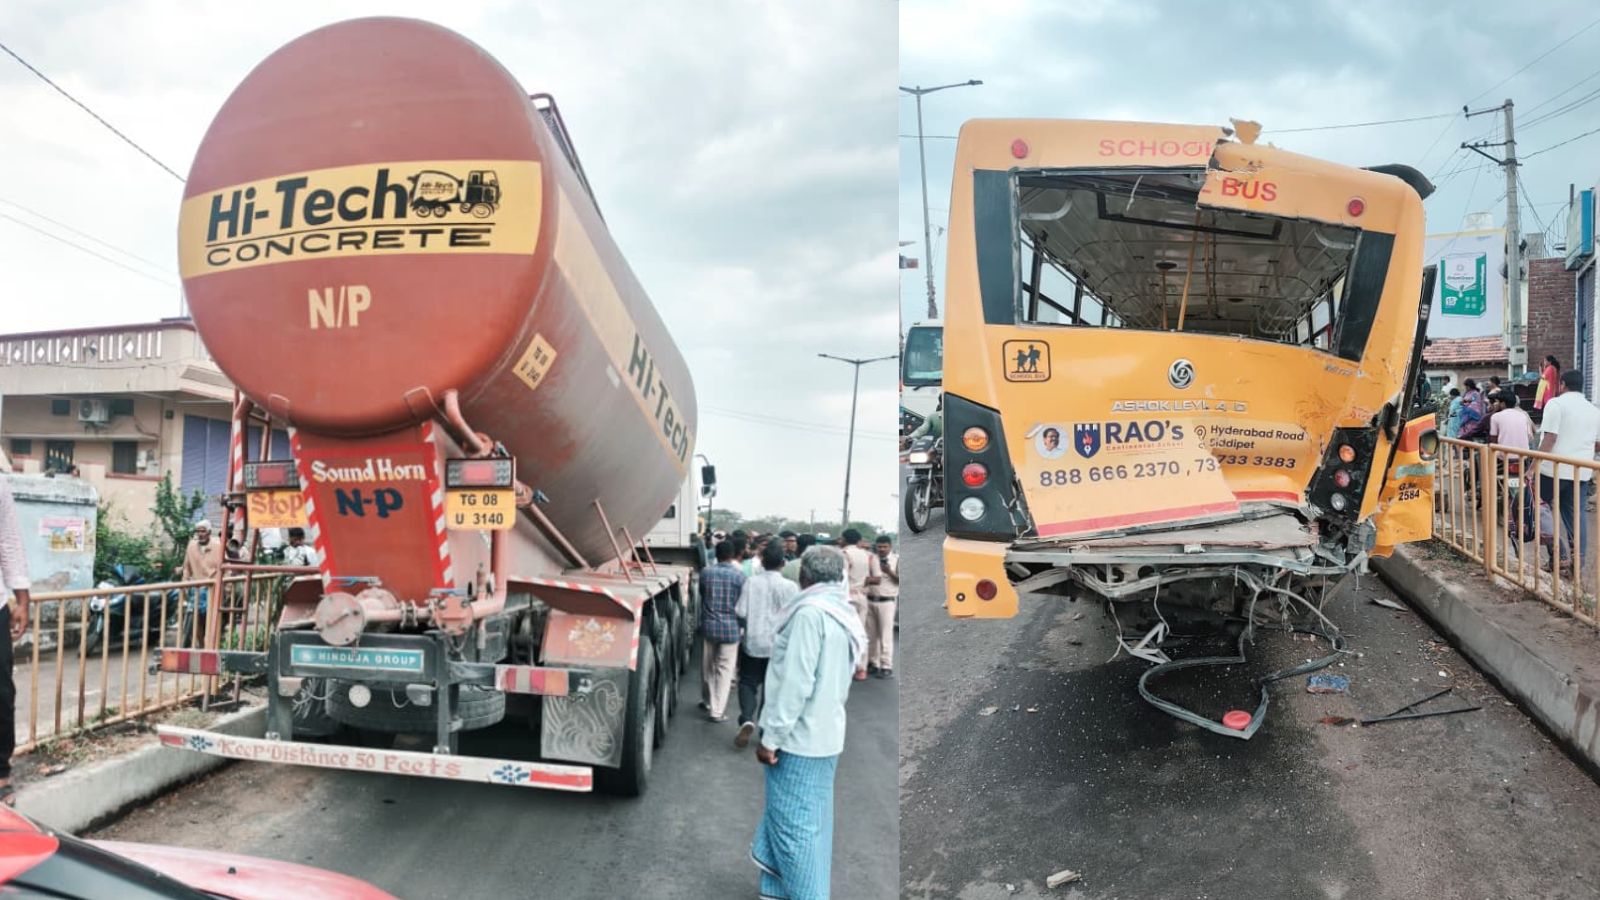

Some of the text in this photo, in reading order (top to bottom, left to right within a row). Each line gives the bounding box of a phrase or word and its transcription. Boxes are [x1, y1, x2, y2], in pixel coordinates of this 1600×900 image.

[1222, 176, 1277, 201] BUS
[207, 168, 409, 242] Hi-Tech
[207, 227, 493, 267] CONCRETE
[308, 284, 372, 329] N/P
[1112, 400, 1170, 411] ASHOK
[1105, 420, 1184, 444] RAO's
[1210, 425, 1305, 441] Hyderabad Road
[1210, 438, 1255, 450] Siddipet
[311, 458, 426, 482] Sound Horn
[1040, 468, 1082, 487] 888
[1089, 465, 1128, 482] 666
[1133, 461, 1180, 478] 2370
[1253, 457, 1296, 469] 3383
[251, 492, 303, 518] Stop
[459, 493, 498, 506] TG 08
[456, 513, 504, 525] U 3140
[375, 655, 416, 665] GROUP
[266, 746, 349, 766] Distance
[355, 754, 376, 769] 50
